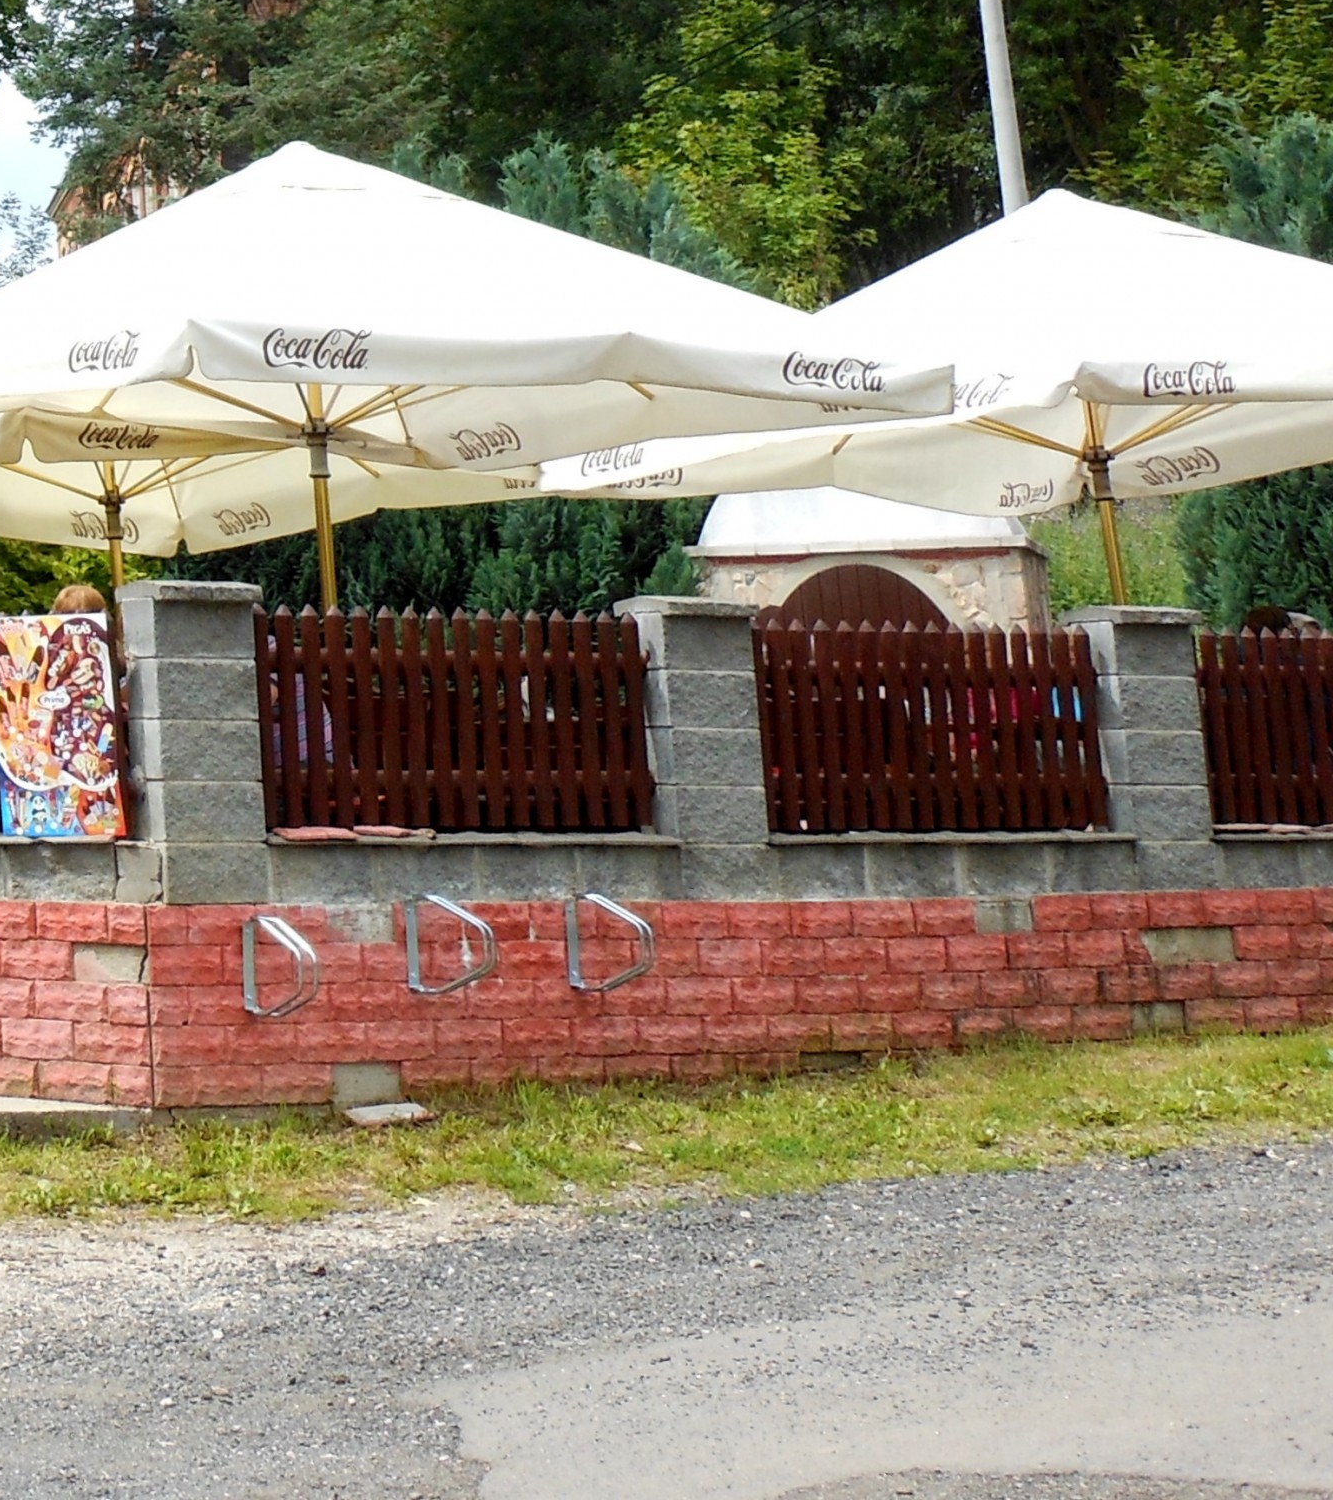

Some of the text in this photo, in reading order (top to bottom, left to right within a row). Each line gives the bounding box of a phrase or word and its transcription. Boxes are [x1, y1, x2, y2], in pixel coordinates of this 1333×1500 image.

[69, 331, 141, 372] Coca-Cola
[262, 328, 372, 370] Coca-Cola
[783, 351, 886, 393] Coca-Cola
[1144, 361, 1235, 398] Coca-Cola
[78, 421, 161, 450] Coca-Cola
